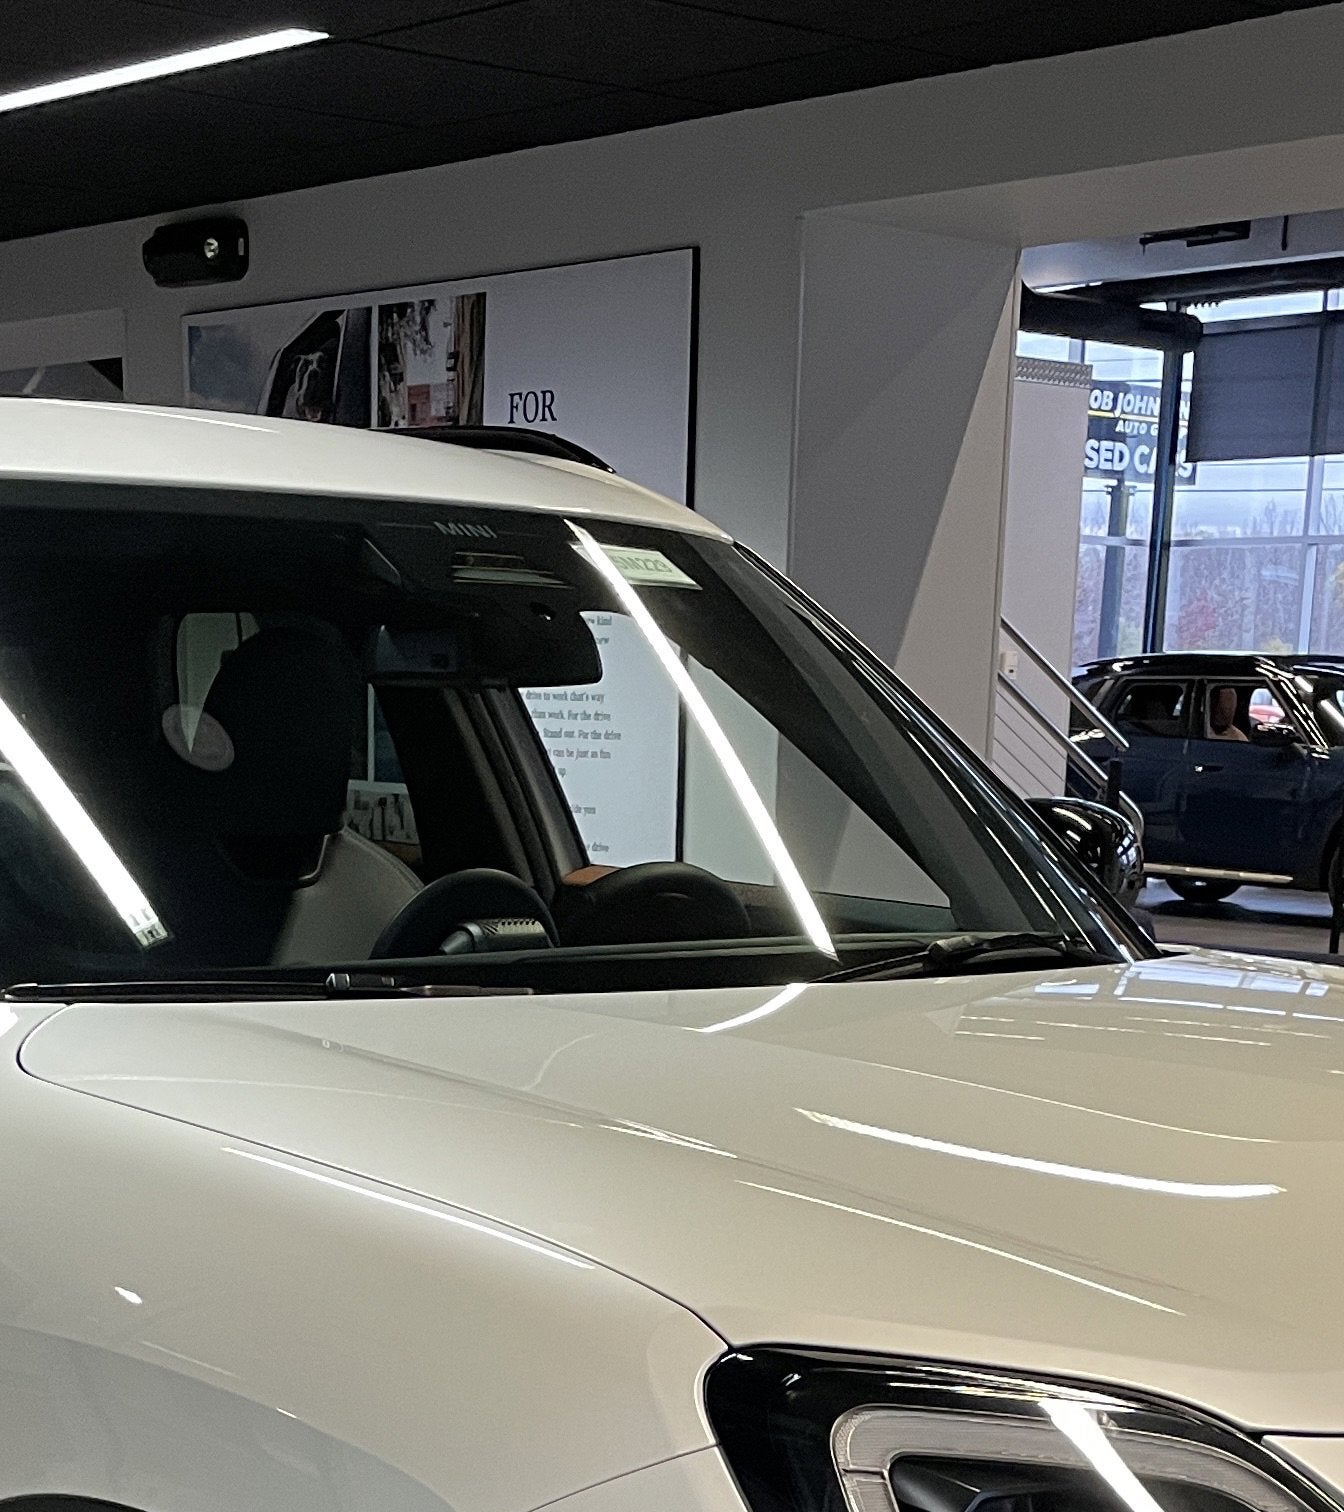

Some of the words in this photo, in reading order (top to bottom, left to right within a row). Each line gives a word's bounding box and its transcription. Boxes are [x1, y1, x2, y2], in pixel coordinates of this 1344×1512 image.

[507, 389, 558, 424] FOR
[1088, 389, 1114, 411] OB
[1115, 419, 1148, 435] AUTO
[1083, 438, 1130, 471] SED
[434, 521, 498, 539] MINI
